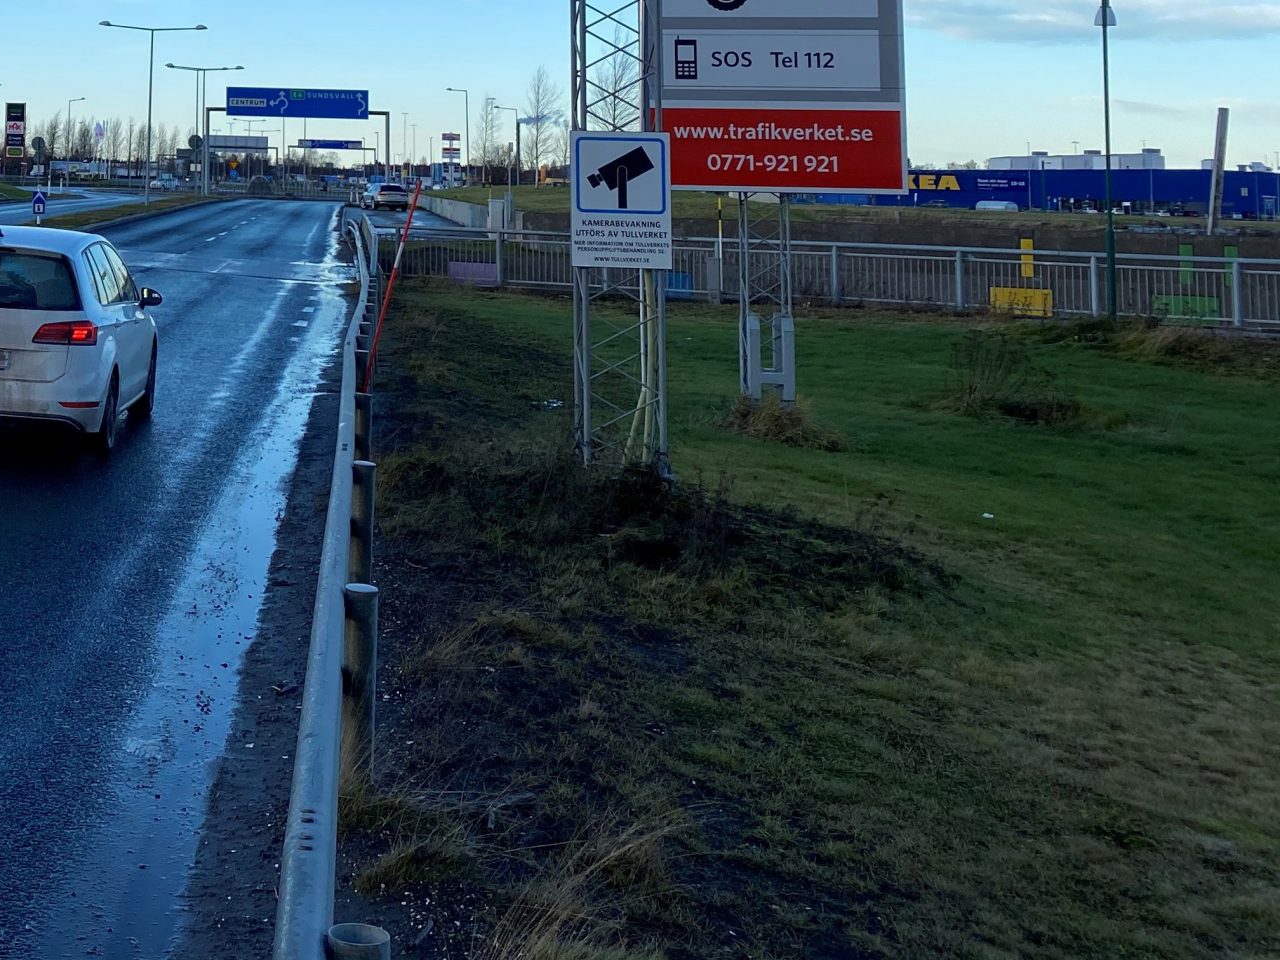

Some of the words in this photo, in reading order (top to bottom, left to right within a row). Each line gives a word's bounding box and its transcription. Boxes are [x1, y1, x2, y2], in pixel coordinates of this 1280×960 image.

[711, 51, 752, 68] SOS
[770, 51, 798, 68] Tel
[804, 52, 835, 68] 112
[306, 92, 355, 100] SUNDSVALL
[230, 98, 265, 106] CENTRUM
[673, 123, 873, 141] www.trafikverket.se
[707, 154, 798, 172] 0771-921
[804, 155, 839, 173] 921
[581, 219, 661, 228] KAMERABEVAKNING
[575, 229, 605, 237] UTFÖRS
[607, 230, 619, 238] AV
[621, 230, 668, 239] TULLVERKET
[577, 246, 657, 254] PERSONUPPGIFTSBEHANDLING
